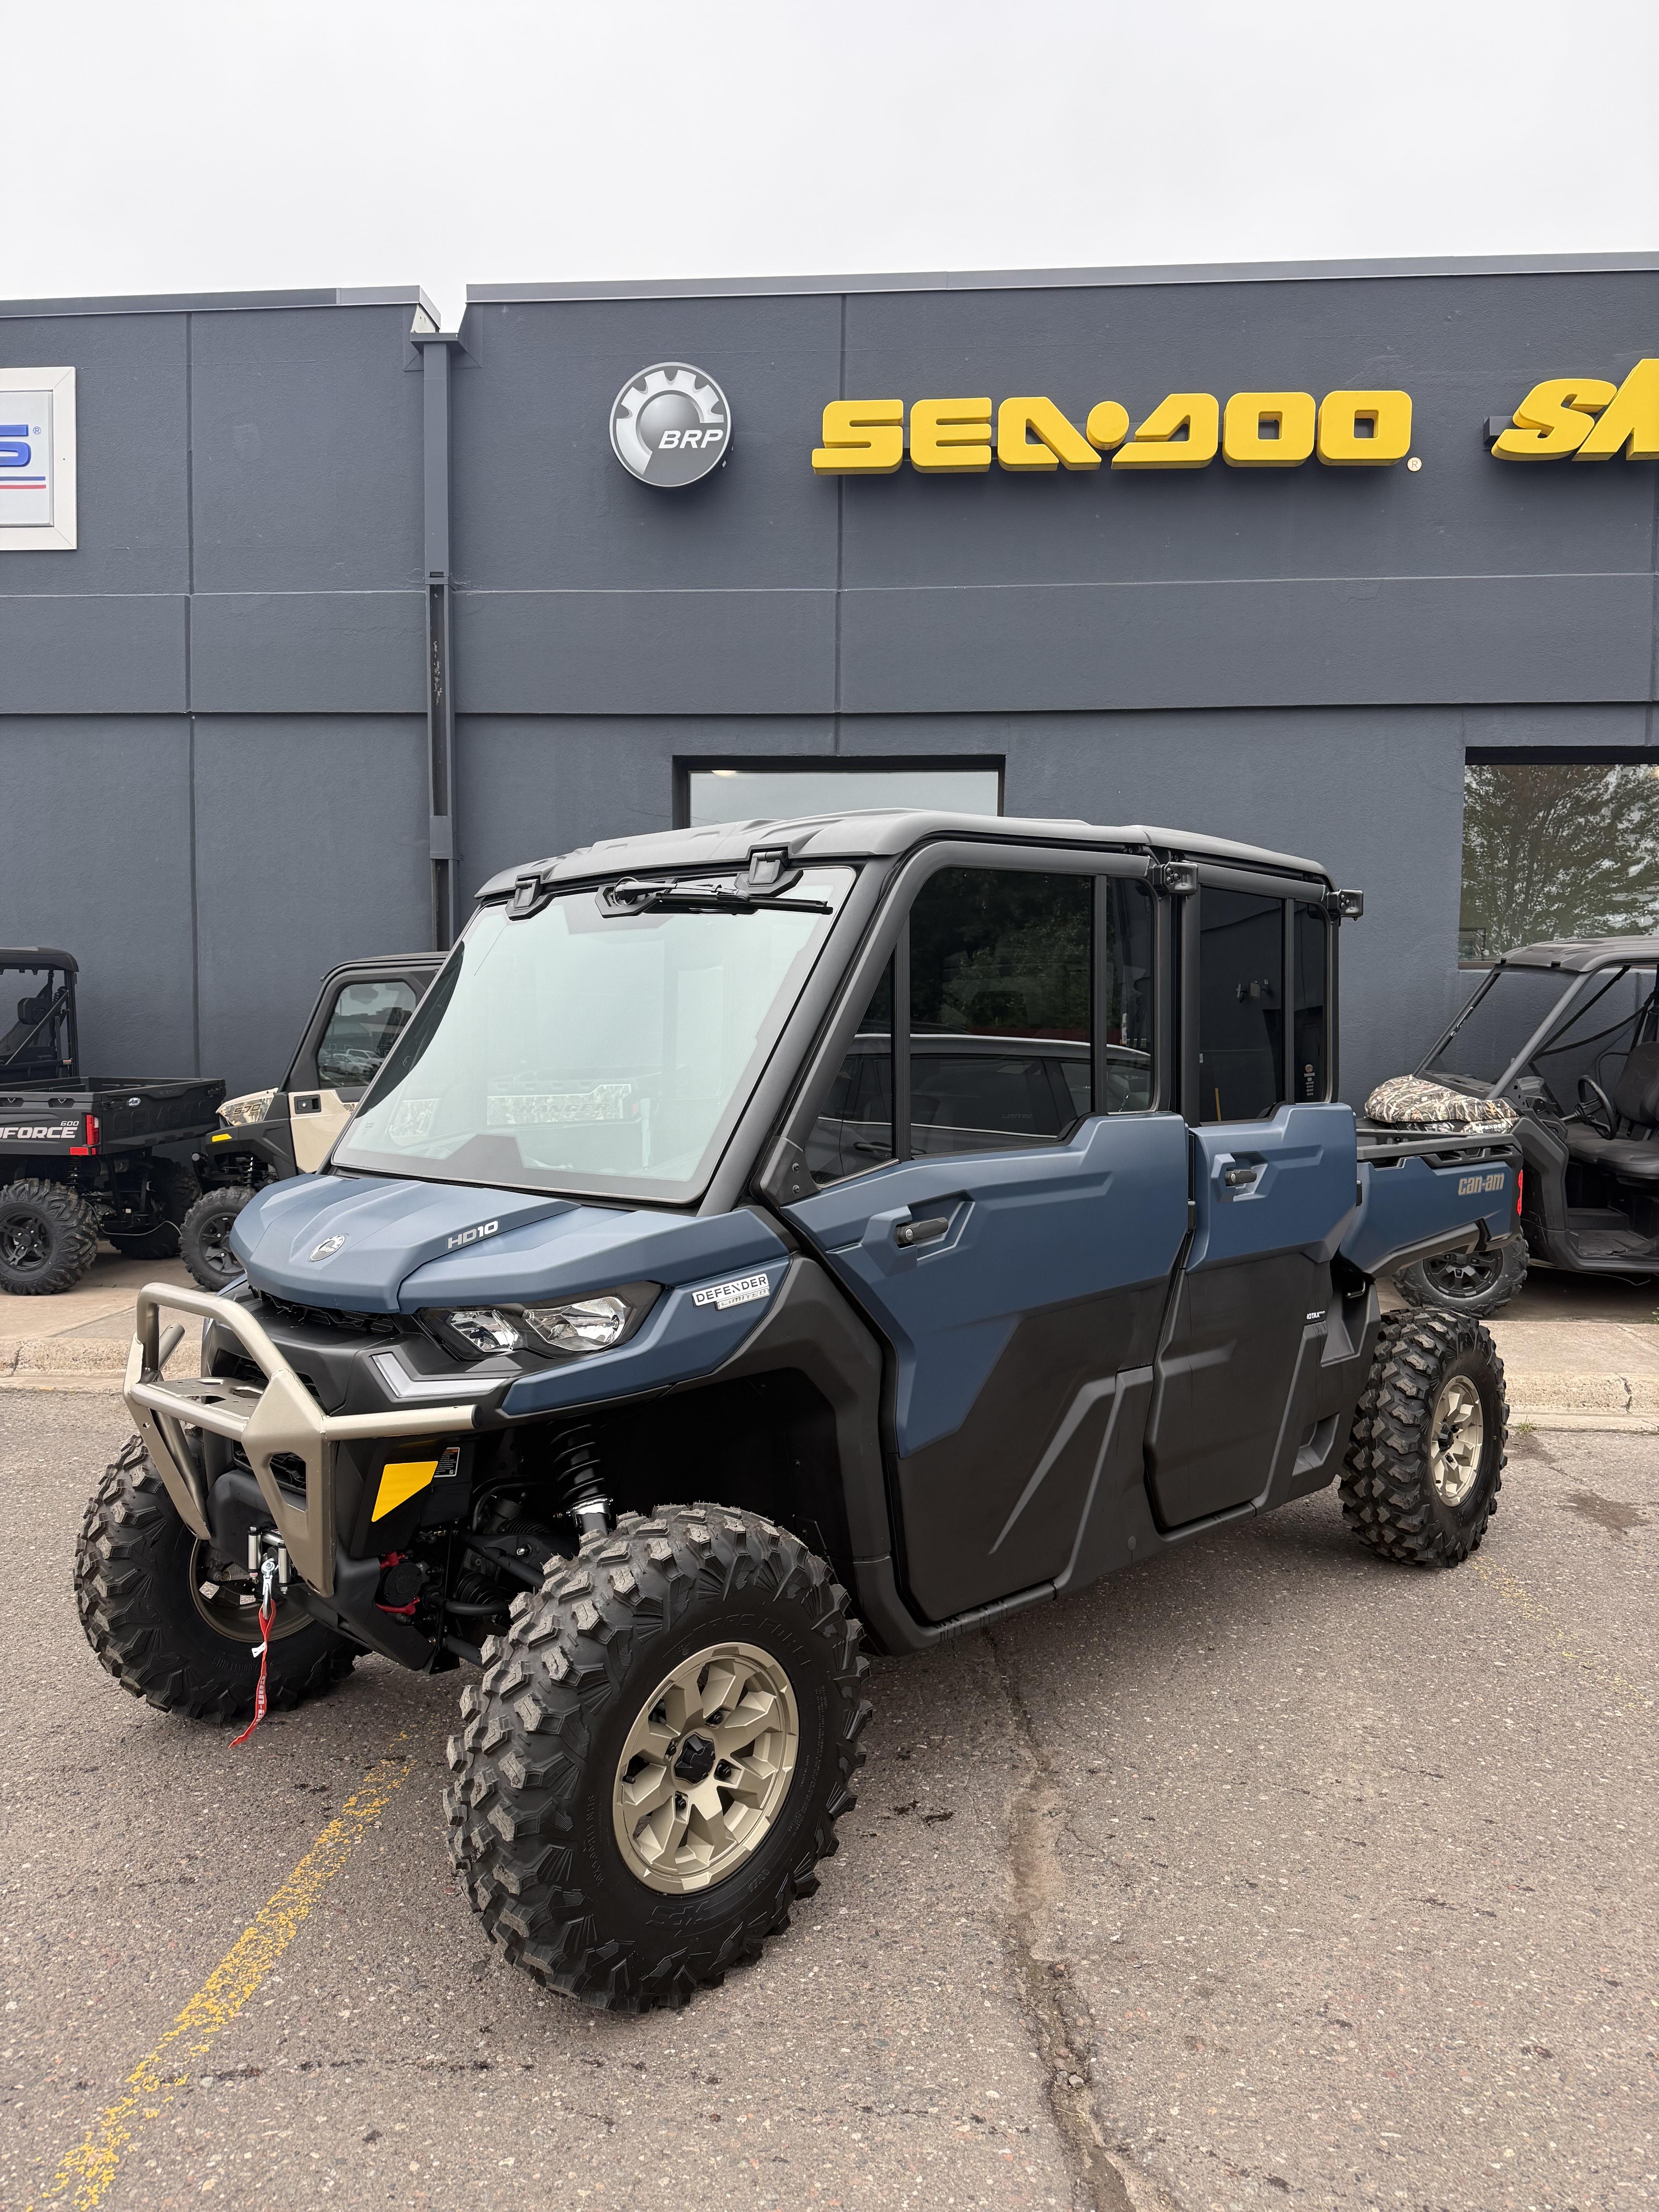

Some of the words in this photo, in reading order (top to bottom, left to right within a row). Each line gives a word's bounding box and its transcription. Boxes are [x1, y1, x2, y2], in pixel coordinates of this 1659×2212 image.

[658, 429, 723, 449] BRP
[517, 1103, 611, 1113] RANGER
[0, 1127, 78, 1139] FORCE
[1458, 1172, 1505, 1196] can-am
[447, 1220, 499, 1249] HD10
[696, 1276, 767, 1303] DEFENDER
[721, 1290, 766, 1307] LIMITED
